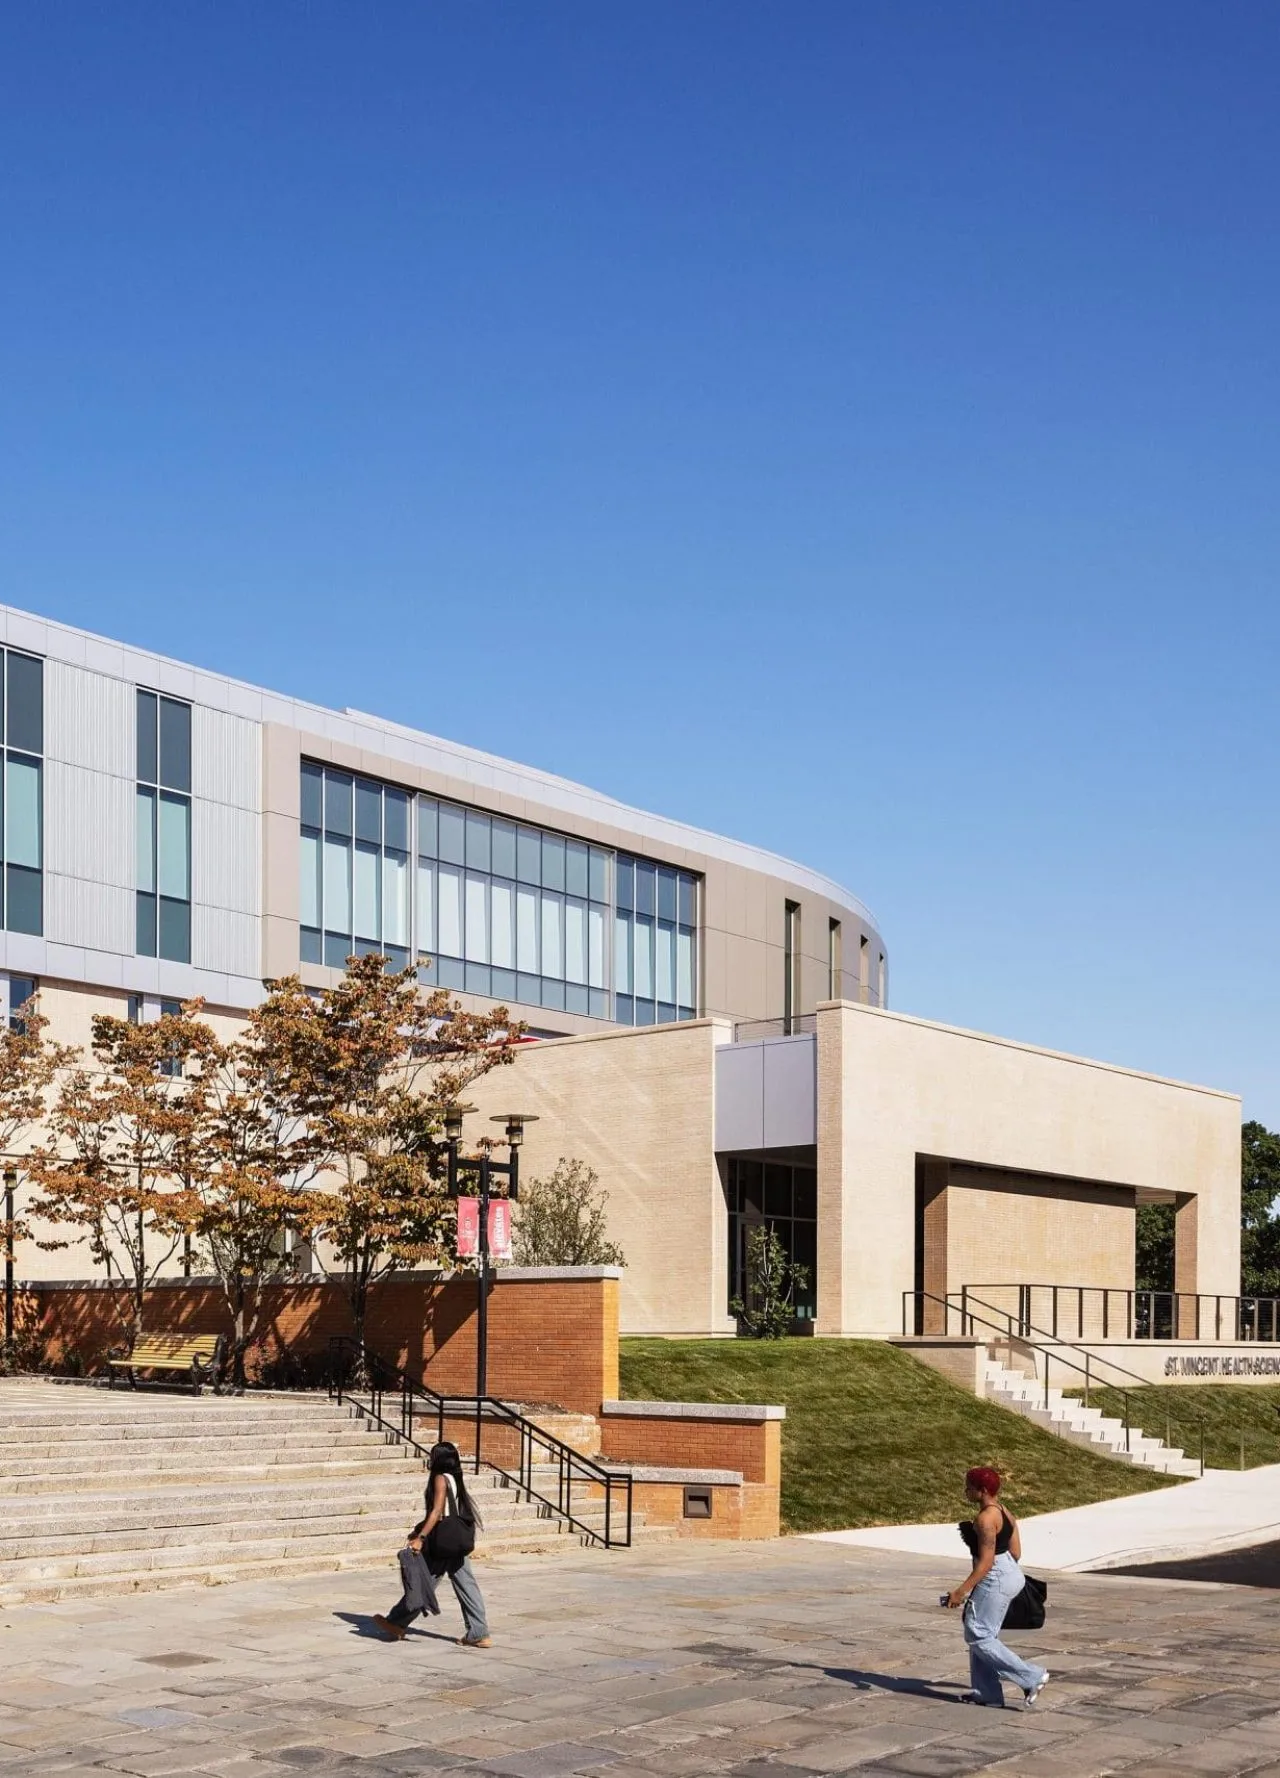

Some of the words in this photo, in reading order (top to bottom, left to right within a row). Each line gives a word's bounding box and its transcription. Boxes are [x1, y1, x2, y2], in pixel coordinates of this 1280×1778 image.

[1164, 1356, 1180, 1376] ST.
[1181, 1356, 1219, 1376] VINCENT
[1220, 1356, 1252, 1376] HEALTH
